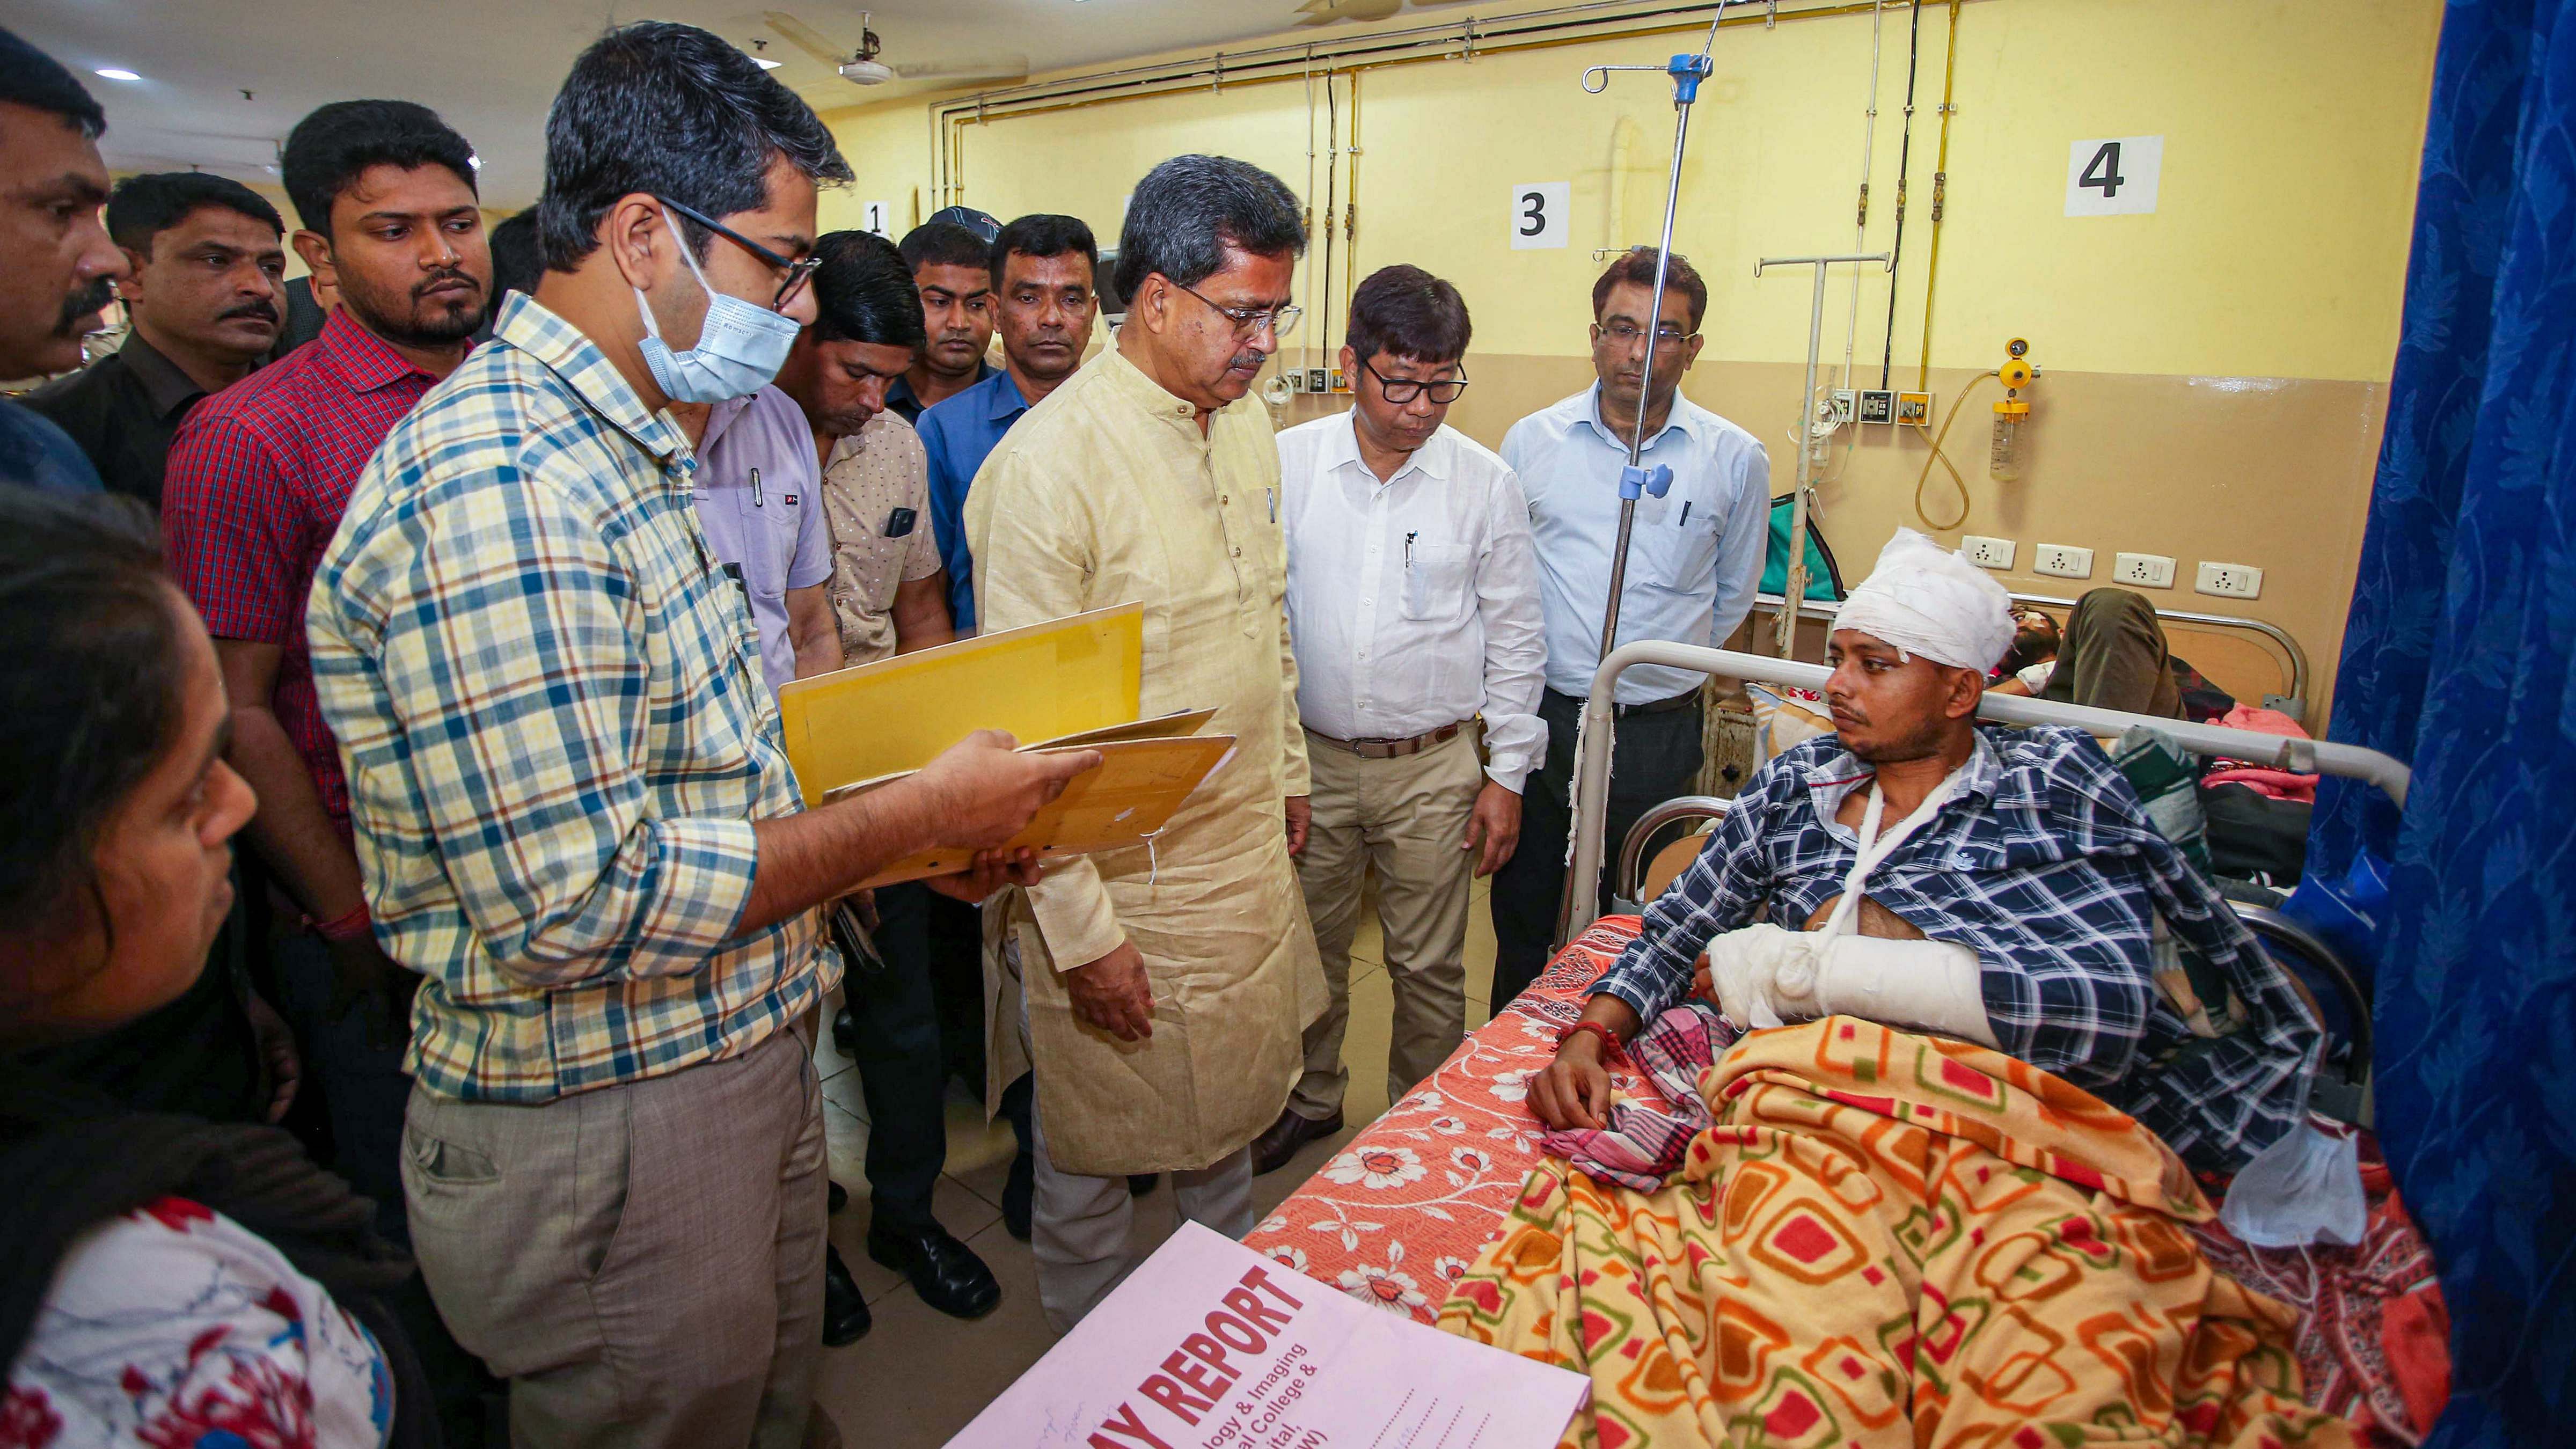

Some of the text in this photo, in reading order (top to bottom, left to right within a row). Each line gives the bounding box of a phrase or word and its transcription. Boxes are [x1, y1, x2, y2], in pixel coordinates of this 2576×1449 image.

[2079, 142, 2124, 197] 4
[870, 204, 881, 232] 1
[1520, 192, 1546, 236] 3
[1137, 1265, 1304, 1426] REPORT
[1236, 1402, 1254, 1415] &
[1247, 1343, 1307, 1400] Imaging
[1251, 1378, 1305, 1433] College
[1299, 1364, 1317, 1376] &
